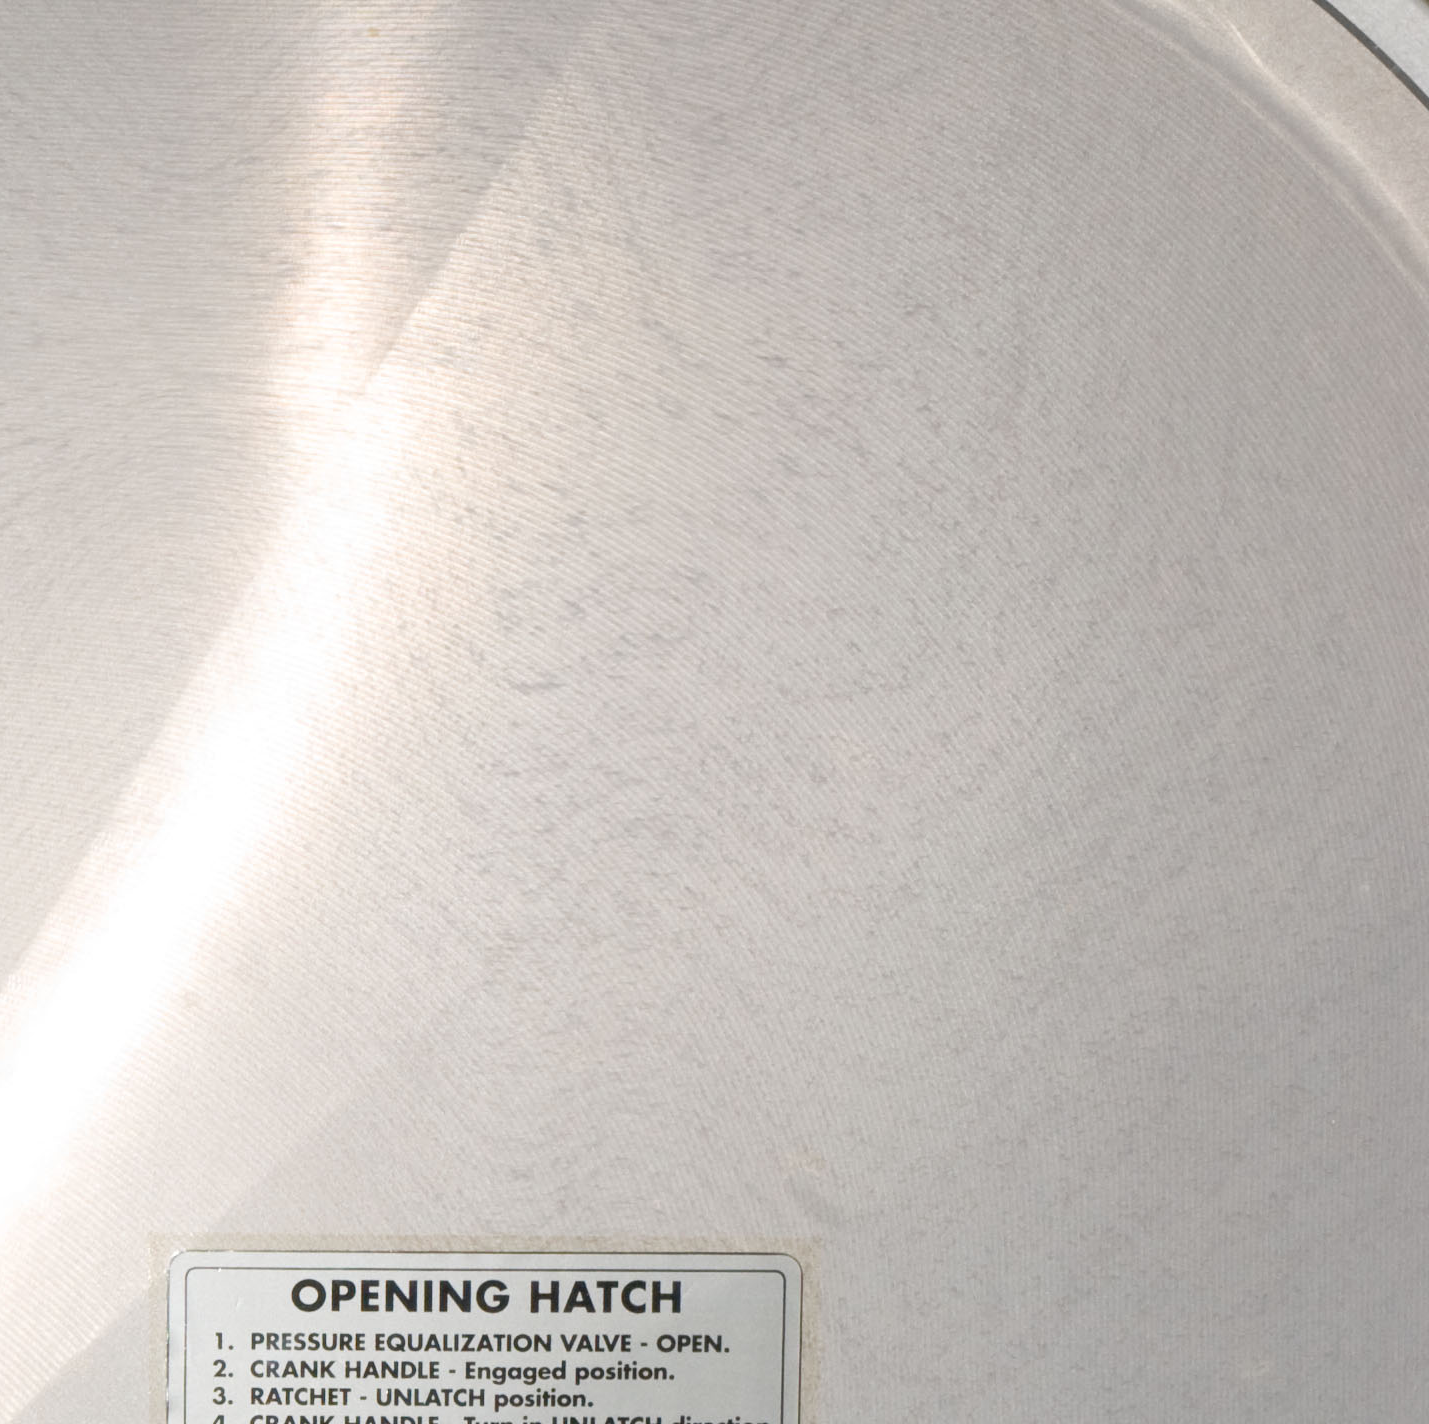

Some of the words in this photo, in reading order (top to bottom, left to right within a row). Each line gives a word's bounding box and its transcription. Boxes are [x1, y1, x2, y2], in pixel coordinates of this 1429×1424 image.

[291, 1277, 510, 1314] OPENING
[530, 1278, 682, 1315] HATCH
[216, 1332, 233, 1351] 1.
[251, 1331, 366, 1352] PRESSURE
[375, 1332, 552, 1353] EQUALIZATION
[560, 1333, 632, 1354] VALVE
[656, 1333, 730, 1354] OPEN.
[213, 1359, 233, 1378] 2.
[250, 1359, 335, 1379] CRANK
[345, 1360, 440, 1380] HANDLE
[465, 1360, 567, 1387] Engaged
[575, 1359, 675, 1387] position.
[213, 1386, 233, 1406] 3.
[251, 1386, 352, 1406] RATCHET
[376, 1387, 485, 1408] UNLATCH
[494, 1387, 594, 1413] position.
